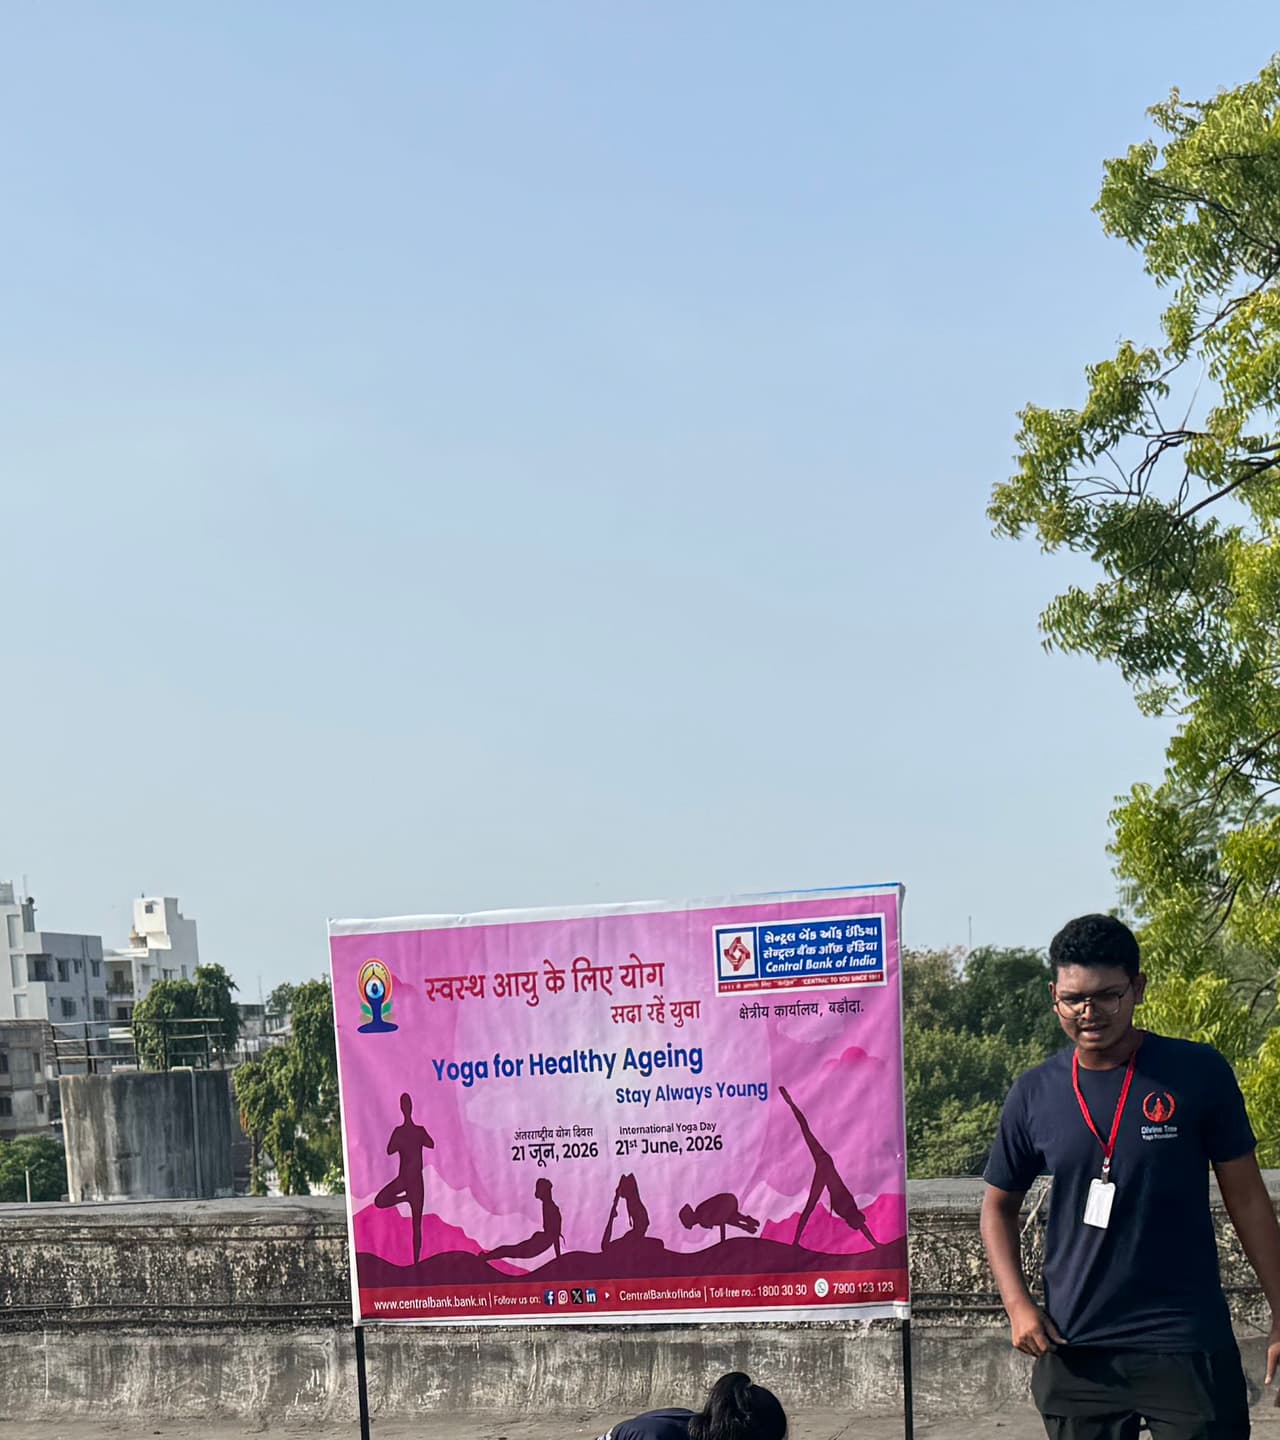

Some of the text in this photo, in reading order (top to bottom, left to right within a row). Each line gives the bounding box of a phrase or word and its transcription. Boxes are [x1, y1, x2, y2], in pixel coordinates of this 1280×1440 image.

[766, 955, 877, 973] Central Bank of India
[425, 953, 665, 1007] स्वस्थ आयु के लिए योग
[610, 995, 702, 1028] सदा रहें युवा
[739, 1003, 769, 1020] क्षेत्रीय
[774, 1000, 823, 1017] कार्यालय,
[432, 1042, 703, 1087] Yoga for Healthy Ageing
[616, 1081, 768, 1107] Stay Always Young
[555, 1125, 571, 1138] योग
[573, 1124, 593, 1138] दिवस
[619, 1121, 717, 1136] International Yoga Day
[511, 1142, 599, 1167] 21 जून, 2026
[615, 1135, 723, 1156] 21st June, 2026
[619, 1288, 702, 1302] CentralBankofIndia
[757, 1285, 780, 1297] 1800
[782, 1285, 794, 1296] 30
[795, 1284, 807, 1296] 30
[832, 1281, 894, 1295] 7900 123 123
[373, 1296, 488, 1311] www.centralbank.bank.in
[494, 1294, 517, 1305] Follow
[518, 1296, 528, 1304] us
